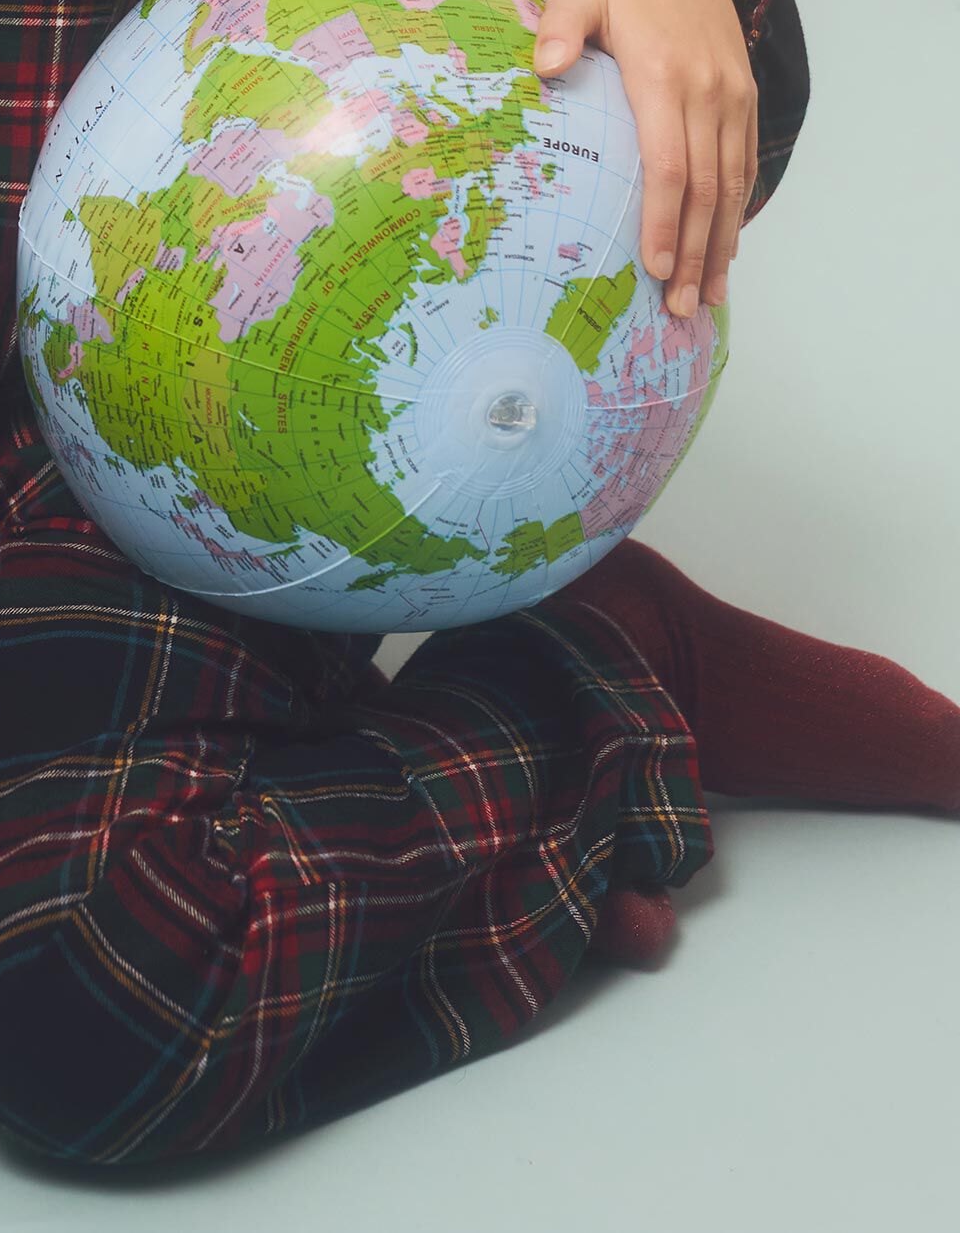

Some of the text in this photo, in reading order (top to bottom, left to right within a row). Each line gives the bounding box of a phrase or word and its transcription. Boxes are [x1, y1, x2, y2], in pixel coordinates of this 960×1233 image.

[230, 66, 264, 97] SAUDI ARABIA
[228, 142, 248, 162] IRAN
[543, 136, 600, 163] EUROPE
[338, 208, 422, 277] COMMONWEALTH
[254, 238, 293, 288] KAZAKHSTAN
[321, 280, 336, 298] OF
[352, 290, 392, 332] RUSSIA
[277, 392, 288, 434] STATES
